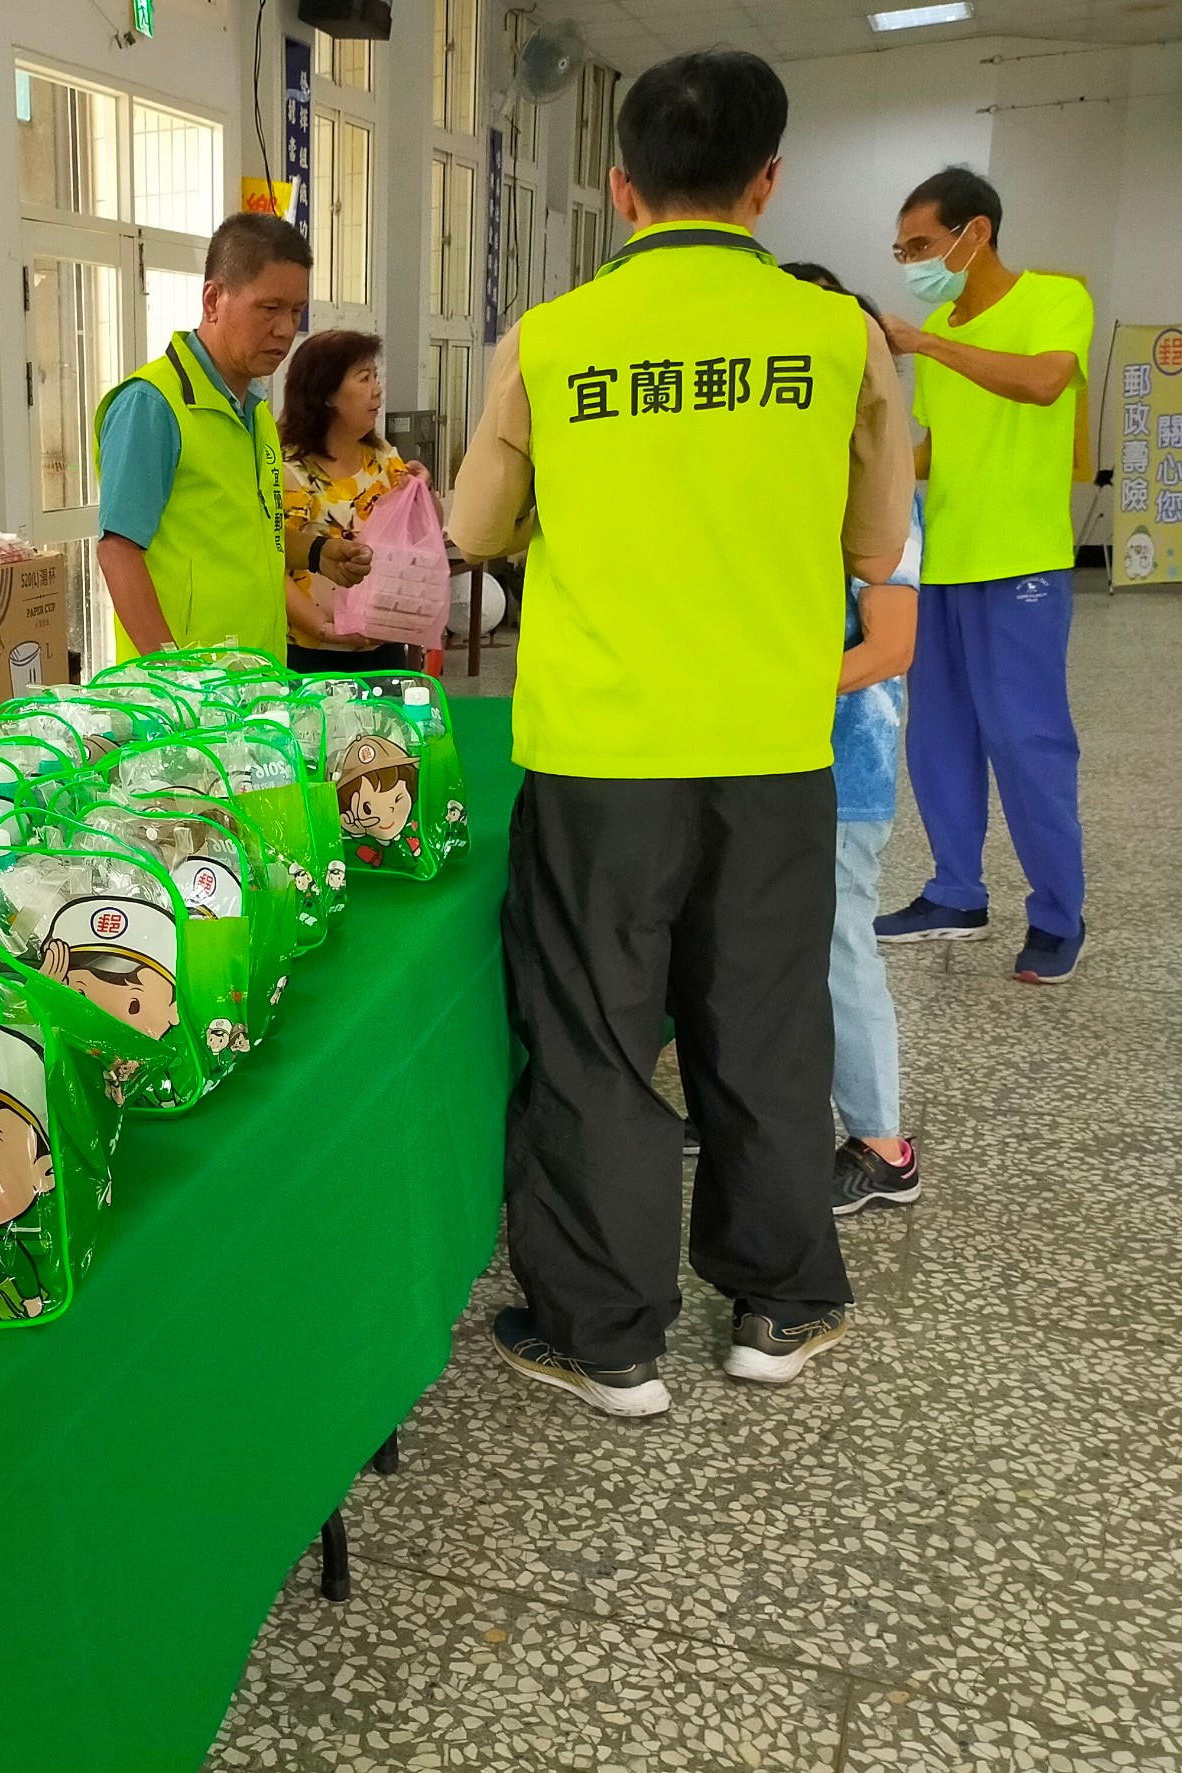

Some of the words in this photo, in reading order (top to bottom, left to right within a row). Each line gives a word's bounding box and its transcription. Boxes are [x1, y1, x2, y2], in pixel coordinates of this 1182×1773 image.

[567, 355, 814, 424] 宜蘭郵局
[1121, 364, 1151, 513] 郵政壽險
[1155, 415, 1182, 524] 關心您
[26, 605, 44, 618] PAPER
[45, 603, 56, 613] CUP
[97, 914, 122, 933] 郵
